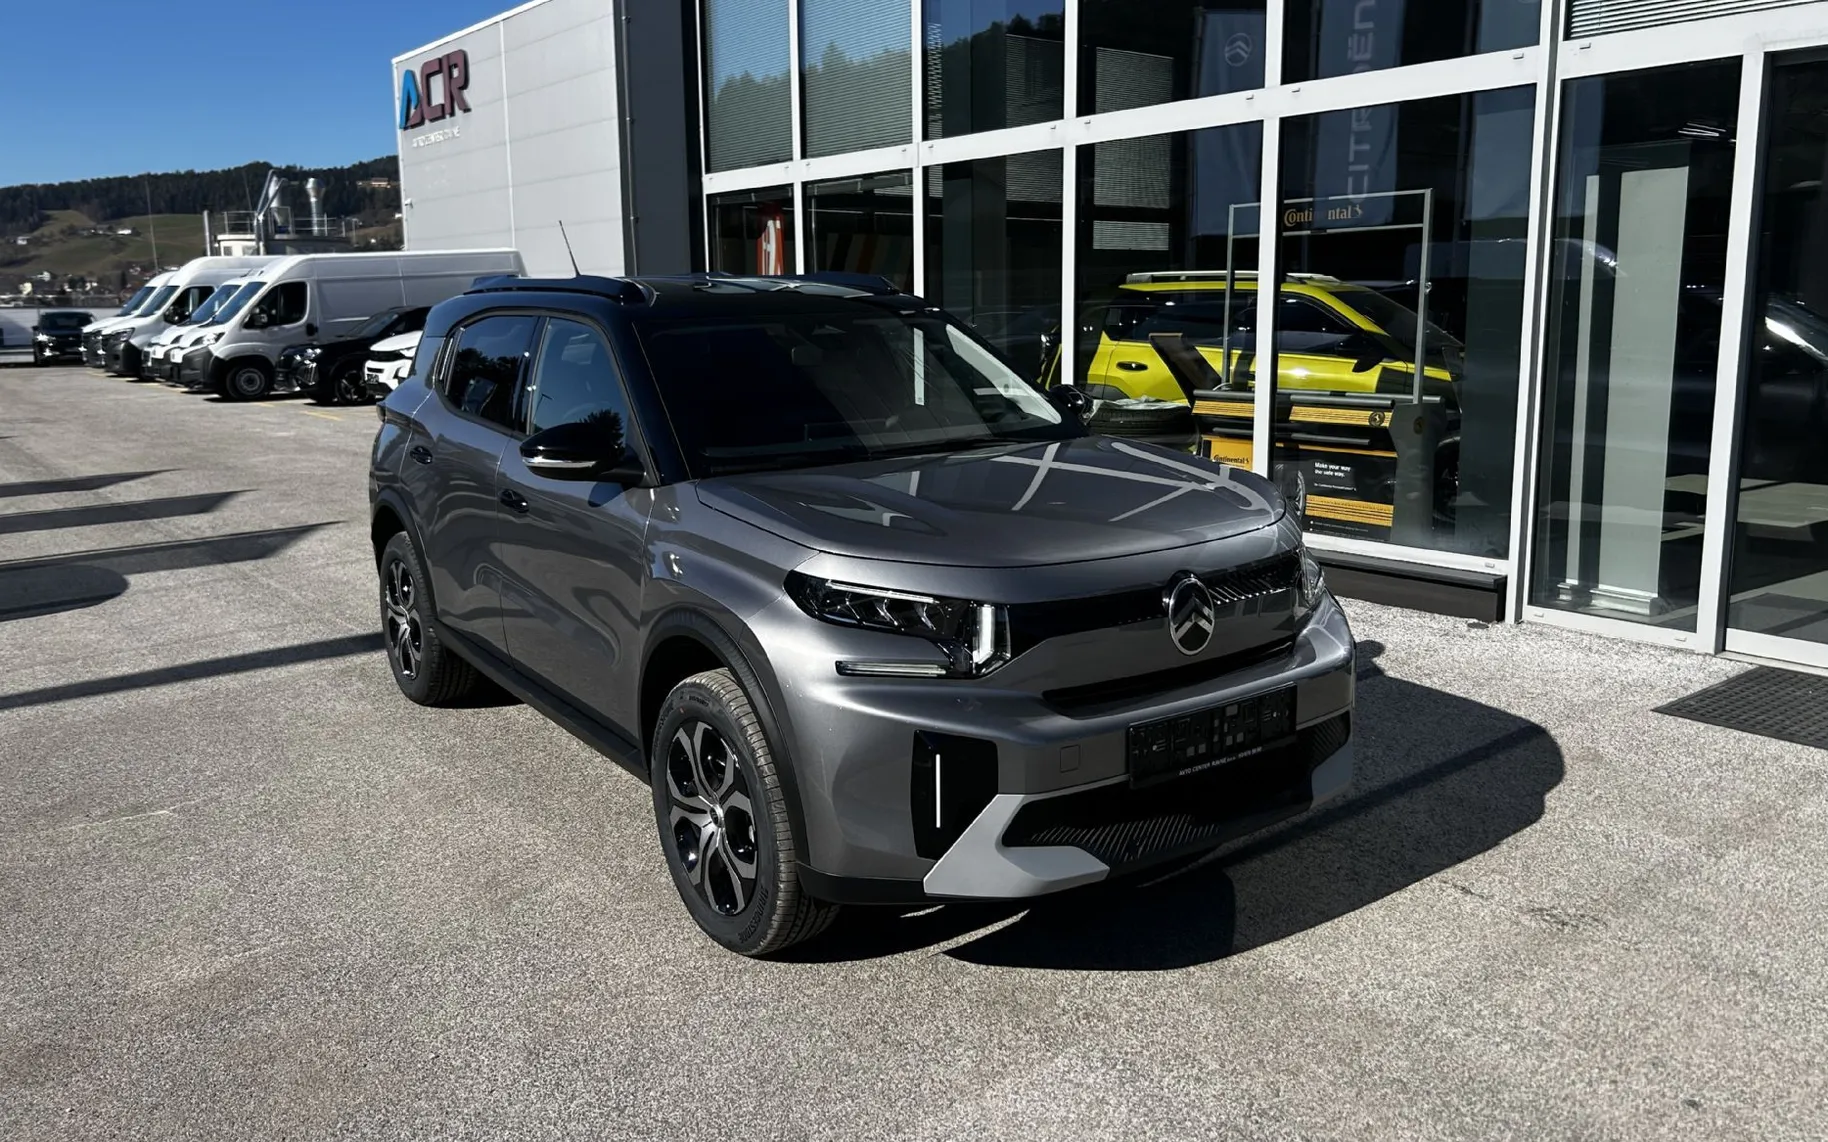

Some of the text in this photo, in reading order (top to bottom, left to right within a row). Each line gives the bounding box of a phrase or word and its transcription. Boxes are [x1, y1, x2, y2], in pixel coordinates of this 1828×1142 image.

[399, 49, 471, 130] ACR
[1347, 0, 1375, 202] CITRËN
[1284, 205, 1352, 227] Contintal
[1192, 763, 1210, 772] CENTER
